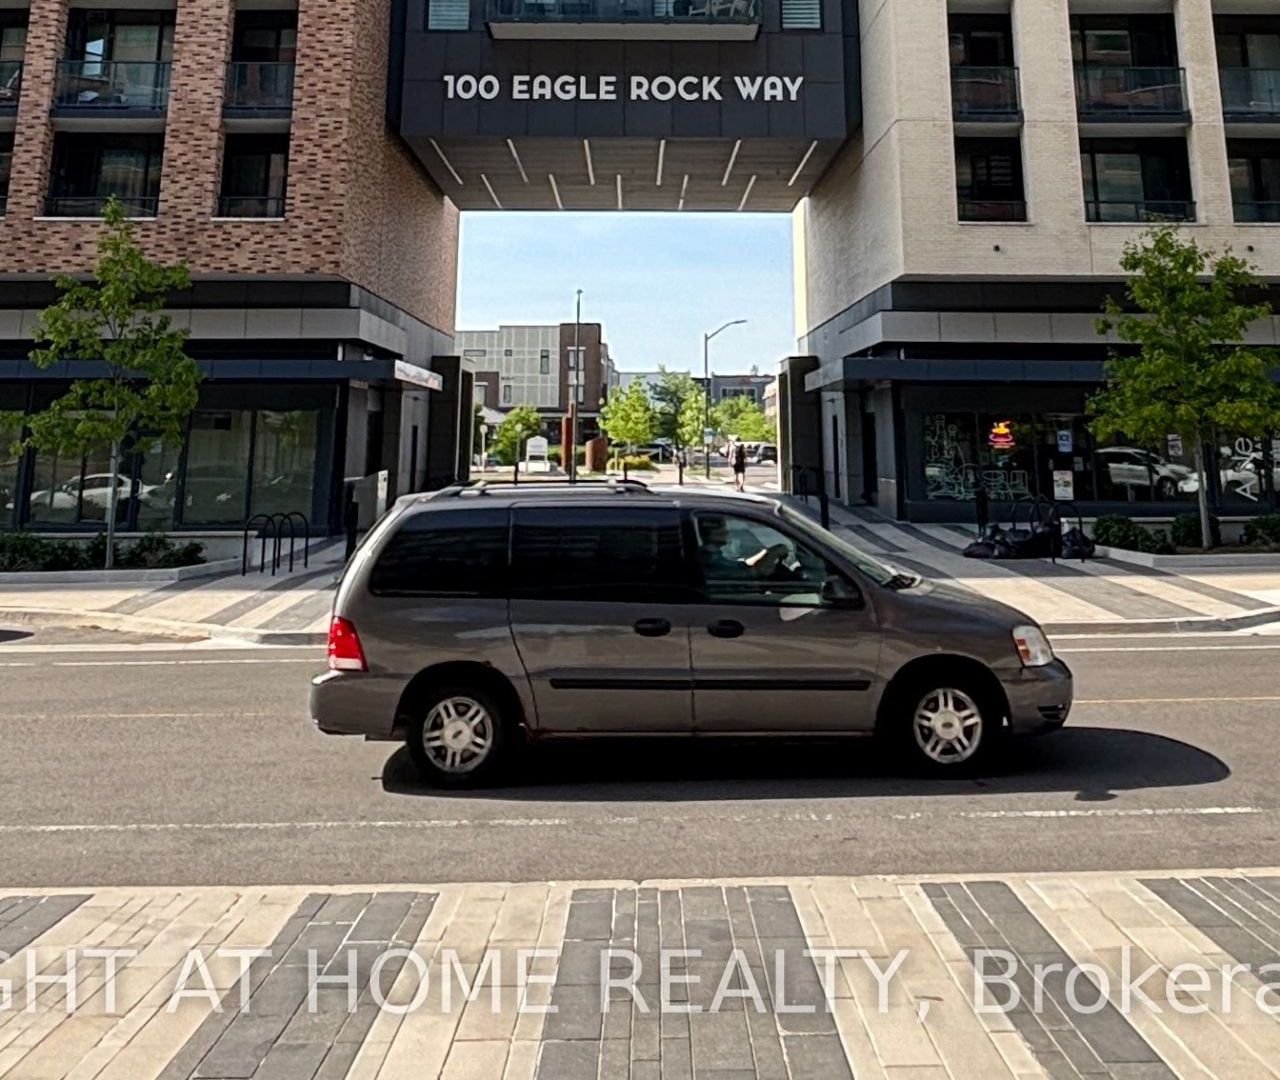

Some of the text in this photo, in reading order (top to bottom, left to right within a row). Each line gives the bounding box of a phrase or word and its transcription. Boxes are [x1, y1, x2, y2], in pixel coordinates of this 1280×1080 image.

[443, 74, 804, 102] 100 EAGLE ROCK WAY
